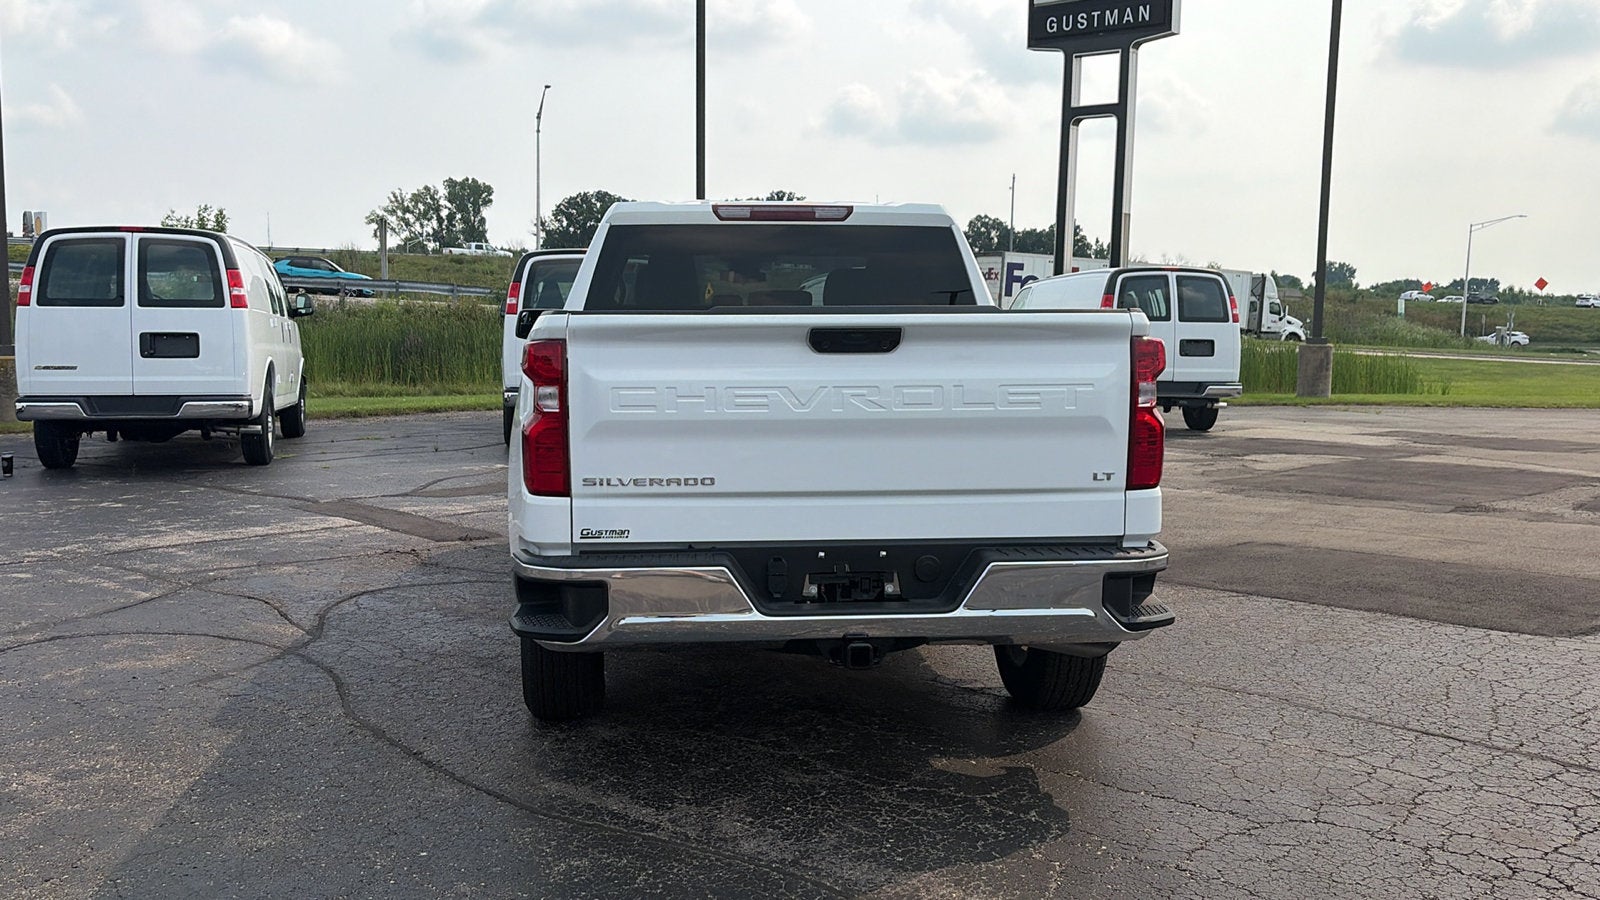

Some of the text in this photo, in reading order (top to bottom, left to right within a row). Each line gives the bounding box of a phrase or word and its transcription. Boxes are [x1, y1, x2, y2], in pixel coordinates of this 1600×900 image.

[1046, 4, 1150, 33] GUSTMAN
[609, 383, 1095, 413] CHEVROLET
[582, 477, 716, 487] SILVERADO
[1092, 471, 1116, 482] LT
